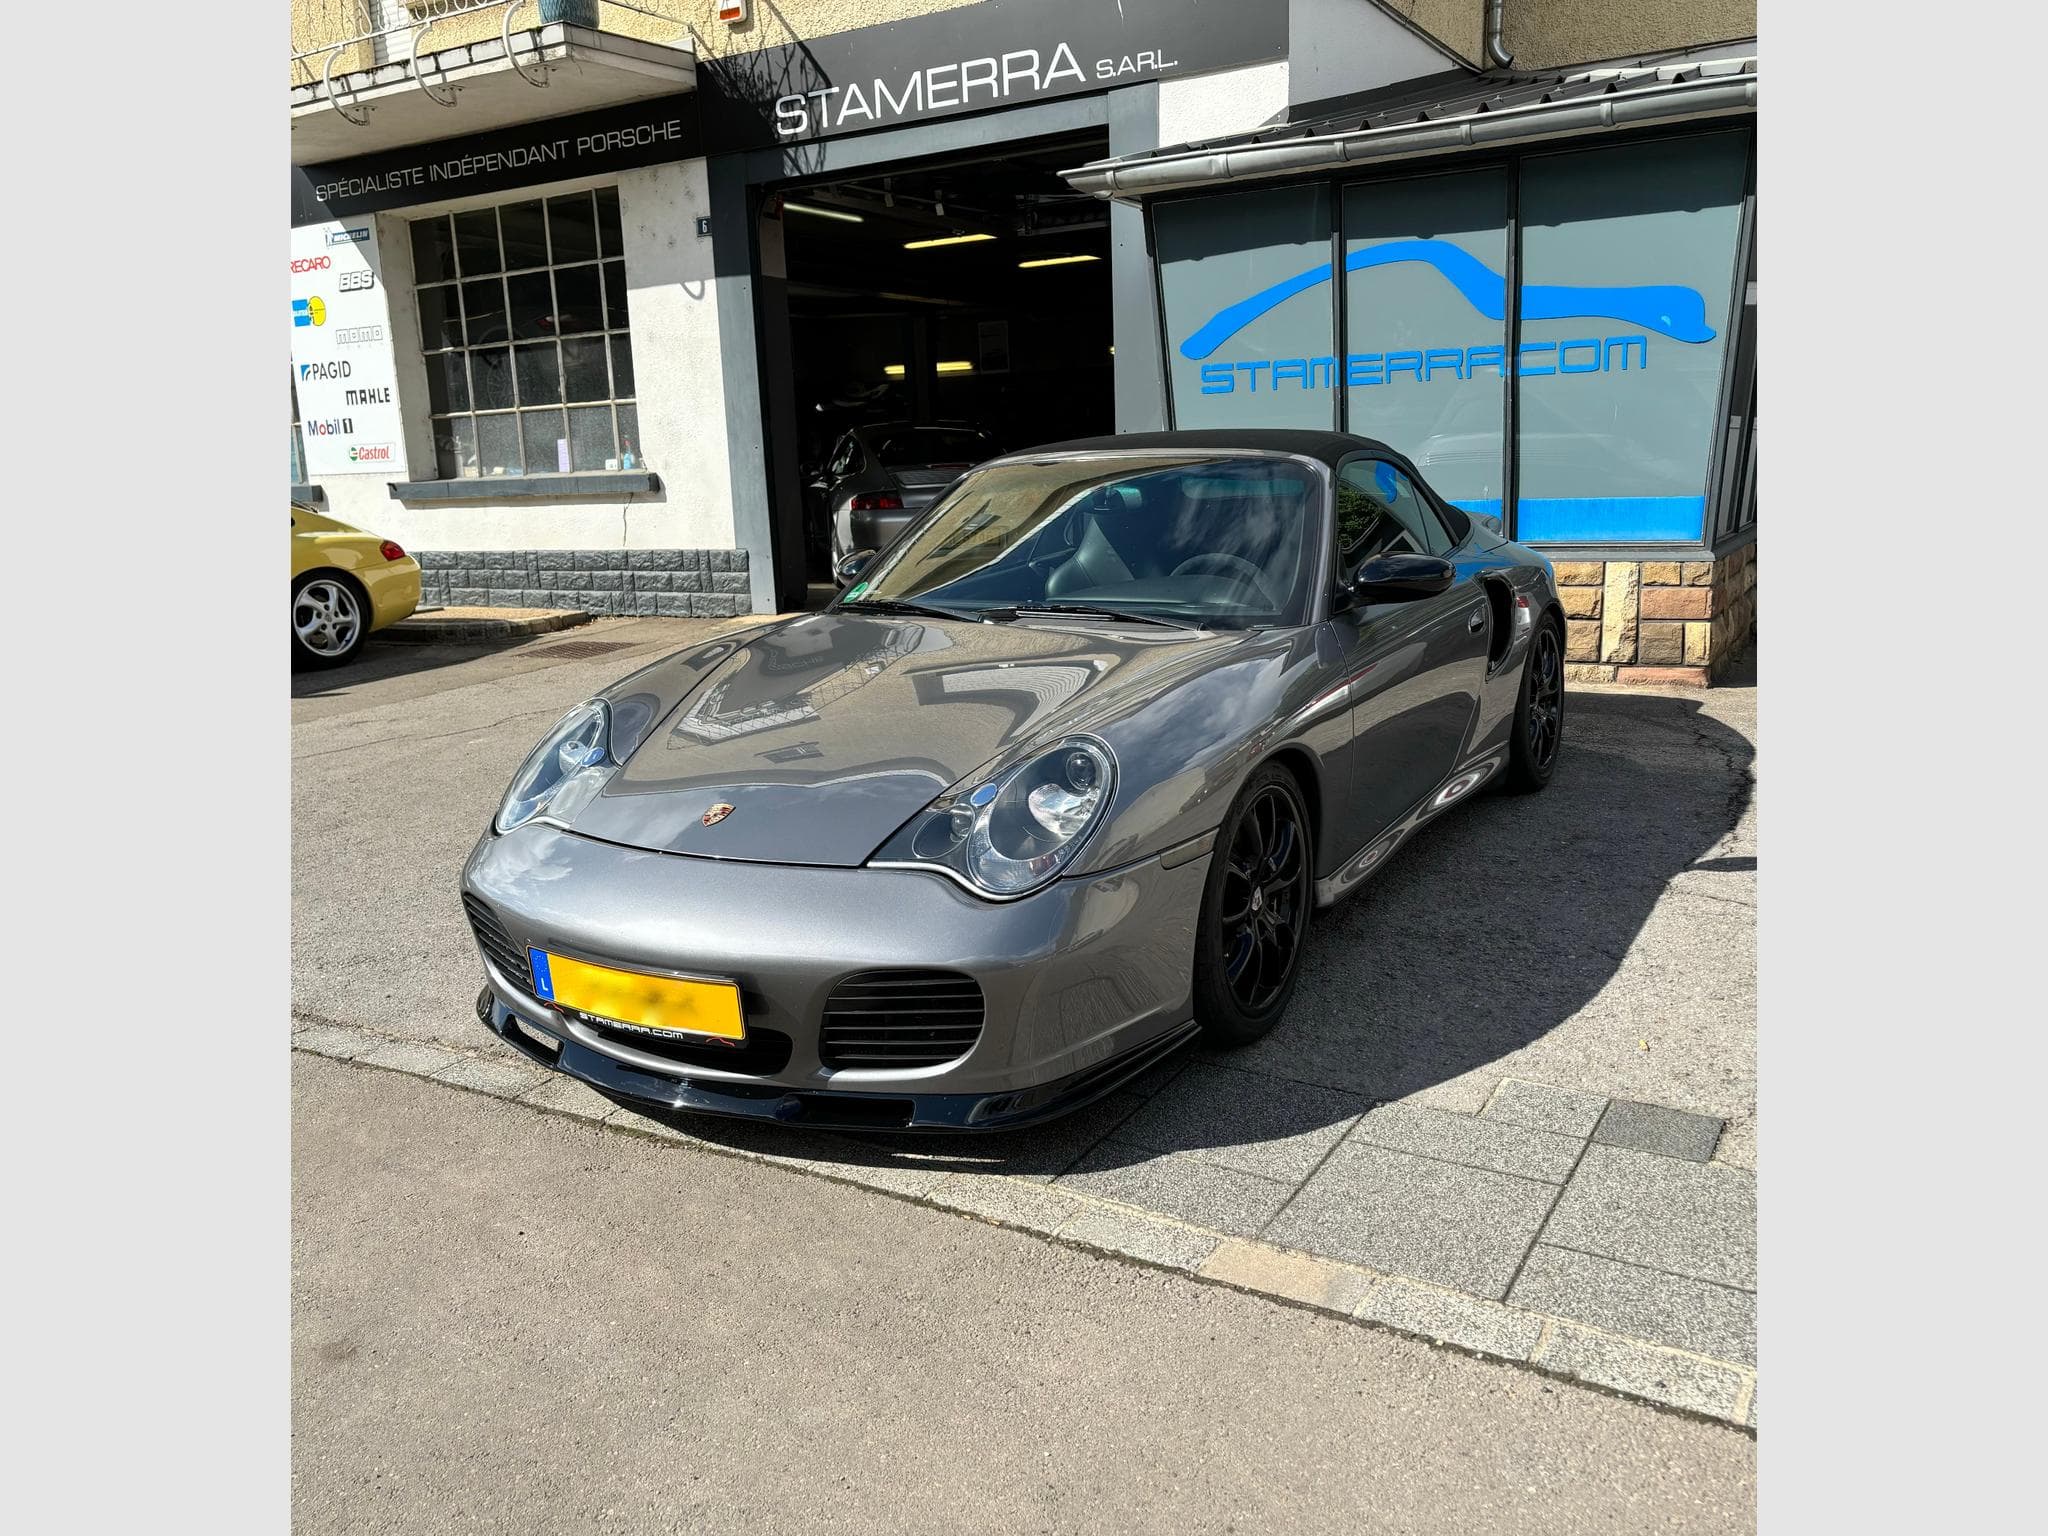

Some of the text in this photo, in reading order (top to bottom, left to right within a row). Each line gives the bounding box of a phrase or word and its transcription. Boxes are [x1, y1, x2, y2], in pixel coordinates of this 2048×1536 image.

[776, 42, 1086, 136] STAMERRA
[316, 119, 682, 202] SPÉCIALISTE INDÉPENDANT PORSCHE
[702, 220, 708, 233] 6
[339, 269, 375, 292] BBS
[312, 360, 352, 381] PAGID
[345, 387, 391, 406] MAHLE
[307, 417, 354, 437] Mobil 1
[358, 445, 390, 461] Castrol
[540, 977, 549, 991] L
